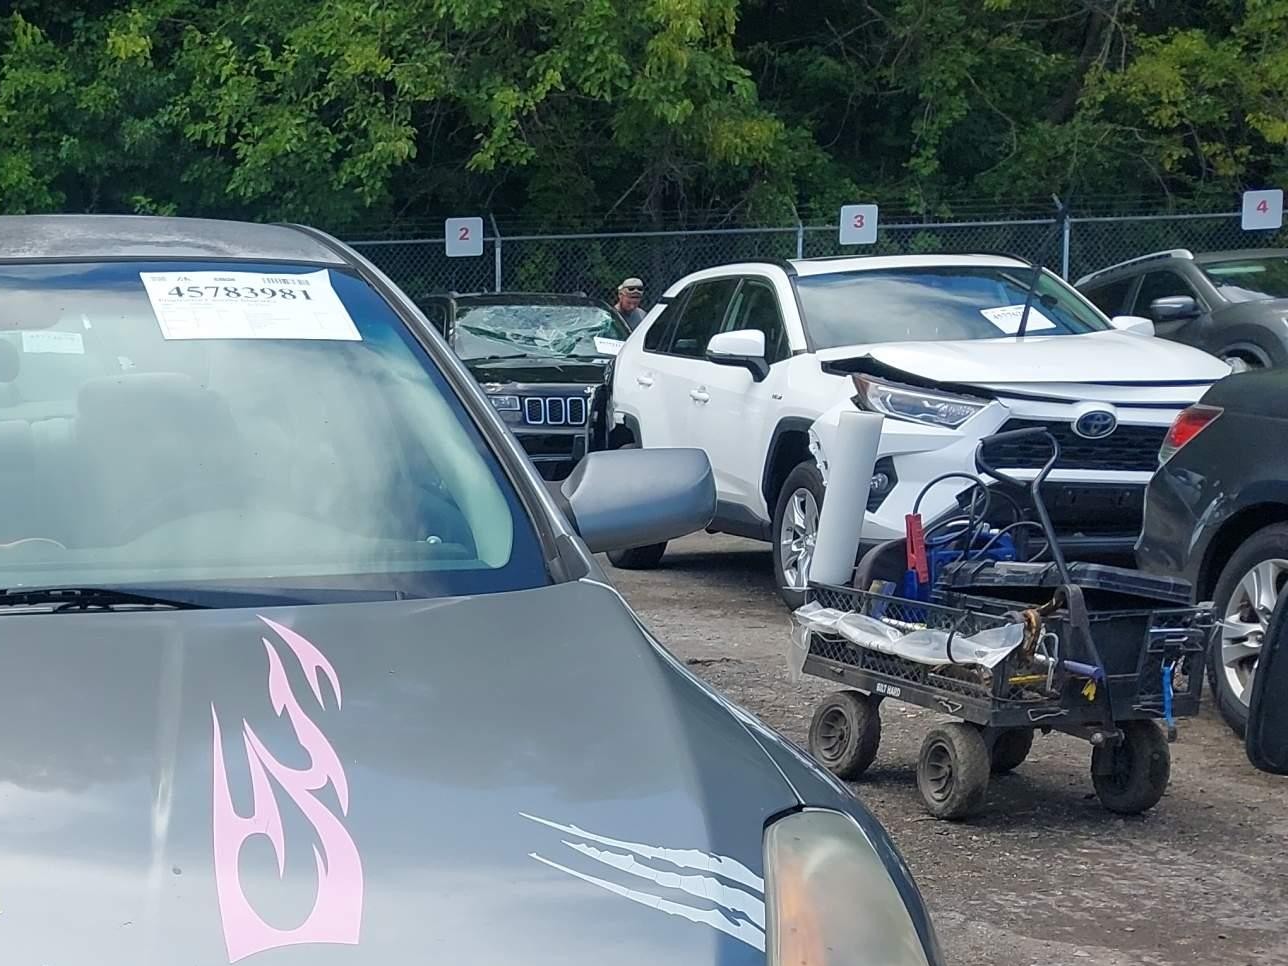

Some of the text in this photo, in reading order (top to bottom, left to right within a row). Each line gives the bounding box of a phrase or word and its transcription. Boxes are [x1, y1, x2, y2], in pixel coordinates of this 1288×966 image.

[1256, 199, 1269, 214] 4
[854, 214, 865, 229] 3
[458, 226, 470, 241] 2
[168, 286, 312, 300] 45783981
